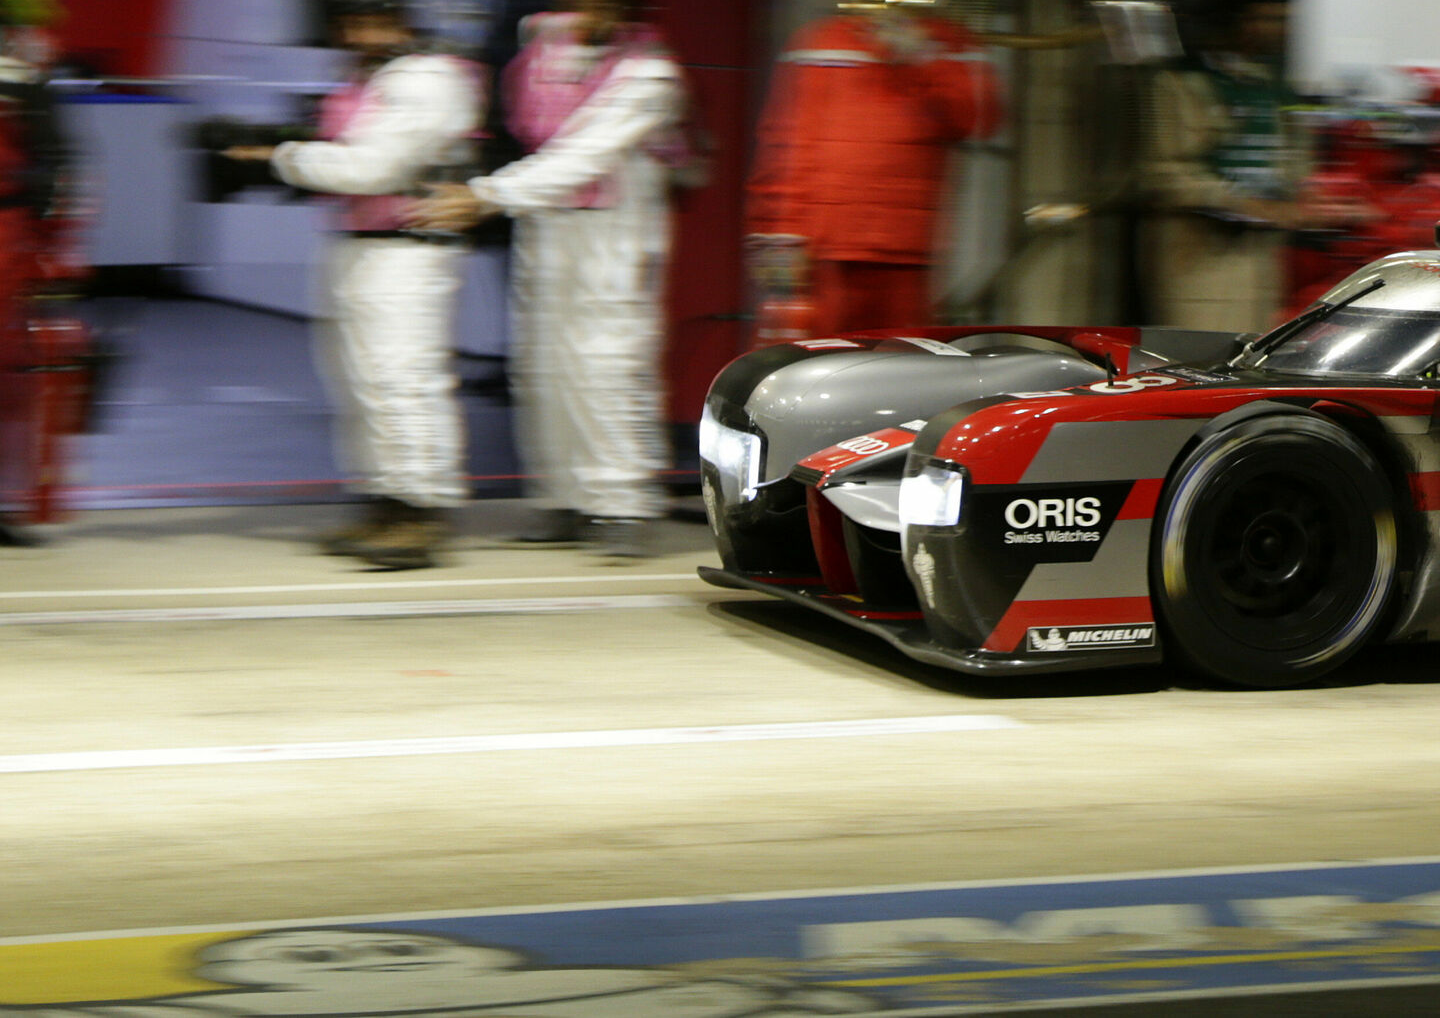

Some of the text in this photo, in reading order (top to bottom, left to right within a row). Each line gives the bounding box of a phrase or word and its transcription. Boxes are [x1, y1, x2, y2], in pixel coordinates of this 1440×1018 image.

[1004, 496, 1102, 530] ORIS
[1004, 529, 1101, 544] Swiss Watches
[1066, 626, 1154, 644] MICHELIN
